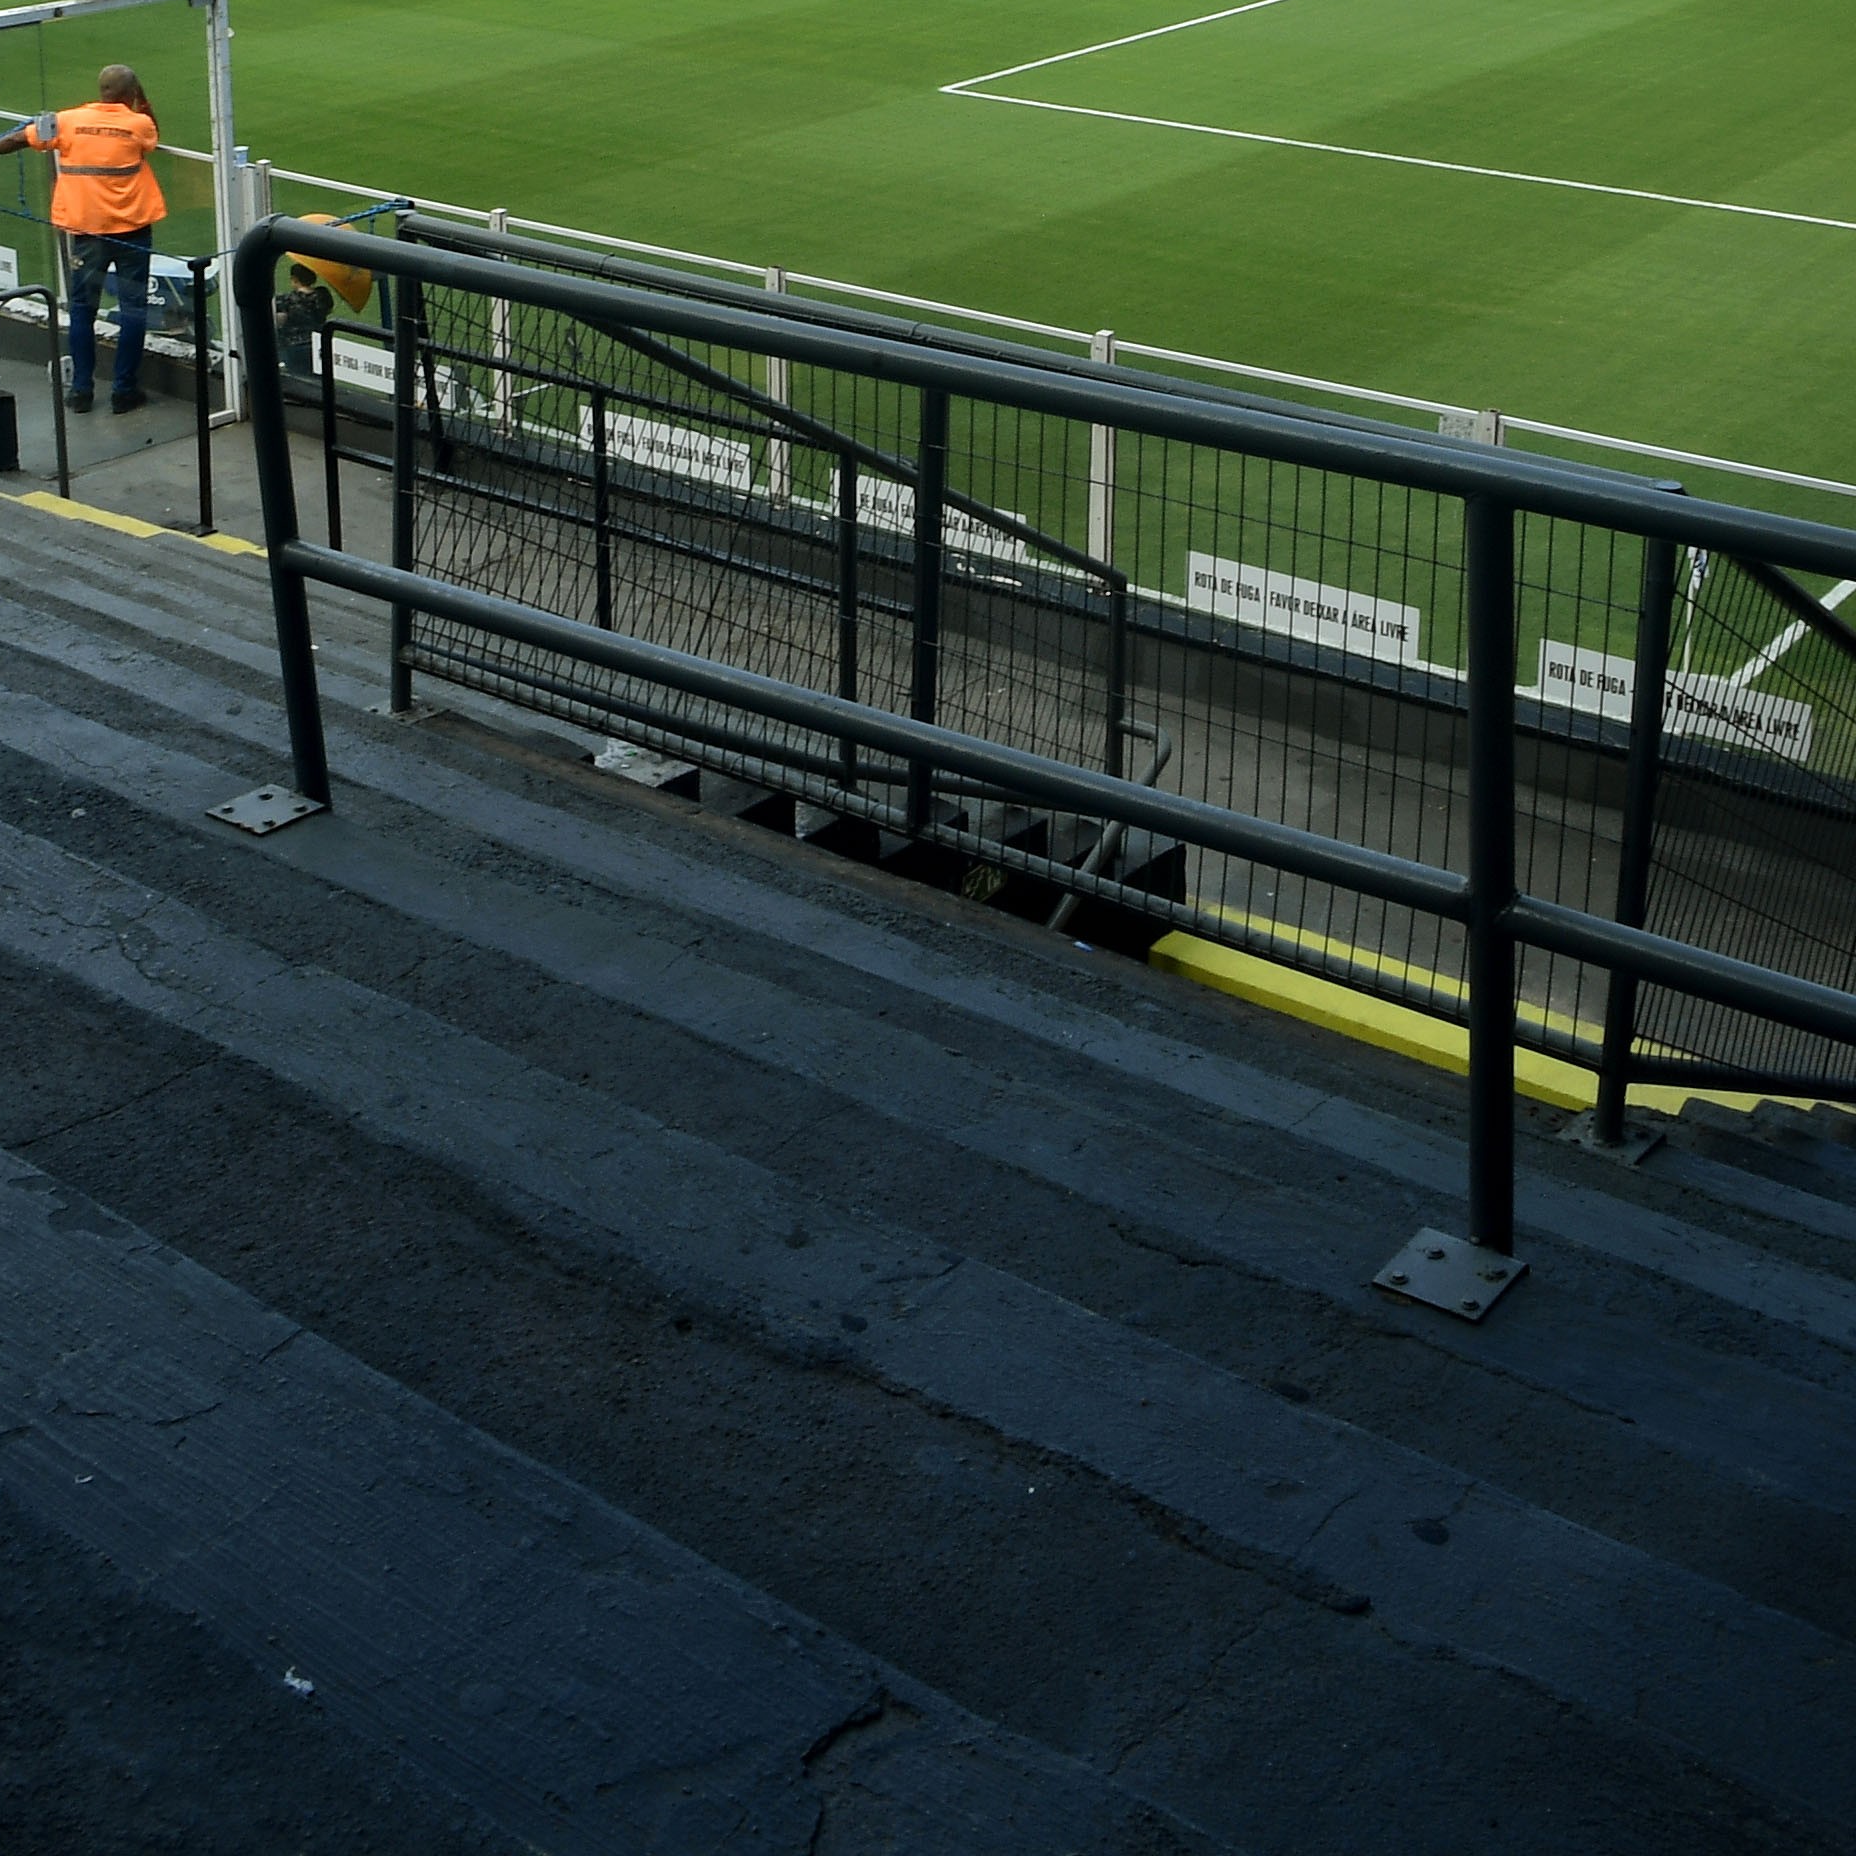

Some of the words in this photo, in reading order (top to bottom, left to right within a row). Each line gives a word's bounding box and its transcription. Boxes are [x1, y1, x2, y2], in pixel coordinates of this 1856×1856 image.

[1194, 571, 1218, 591] ROTA
[1220, 577, 1233, 595] DE
[1235, 581, 1261, 603] FUGA
[1270, 590, 1301, 613] FAVOR
[1303, 599, 1339, 624] DEIXAR
[1351, 609, 1378, 634] ÁREA
[1380, 619, 1409, 642] LIVRE
[1548, 661, 1576, 684] ROTA
[1579, 668, 1595, 689] DE
[1596, 673, 1626, 697] FUGA
